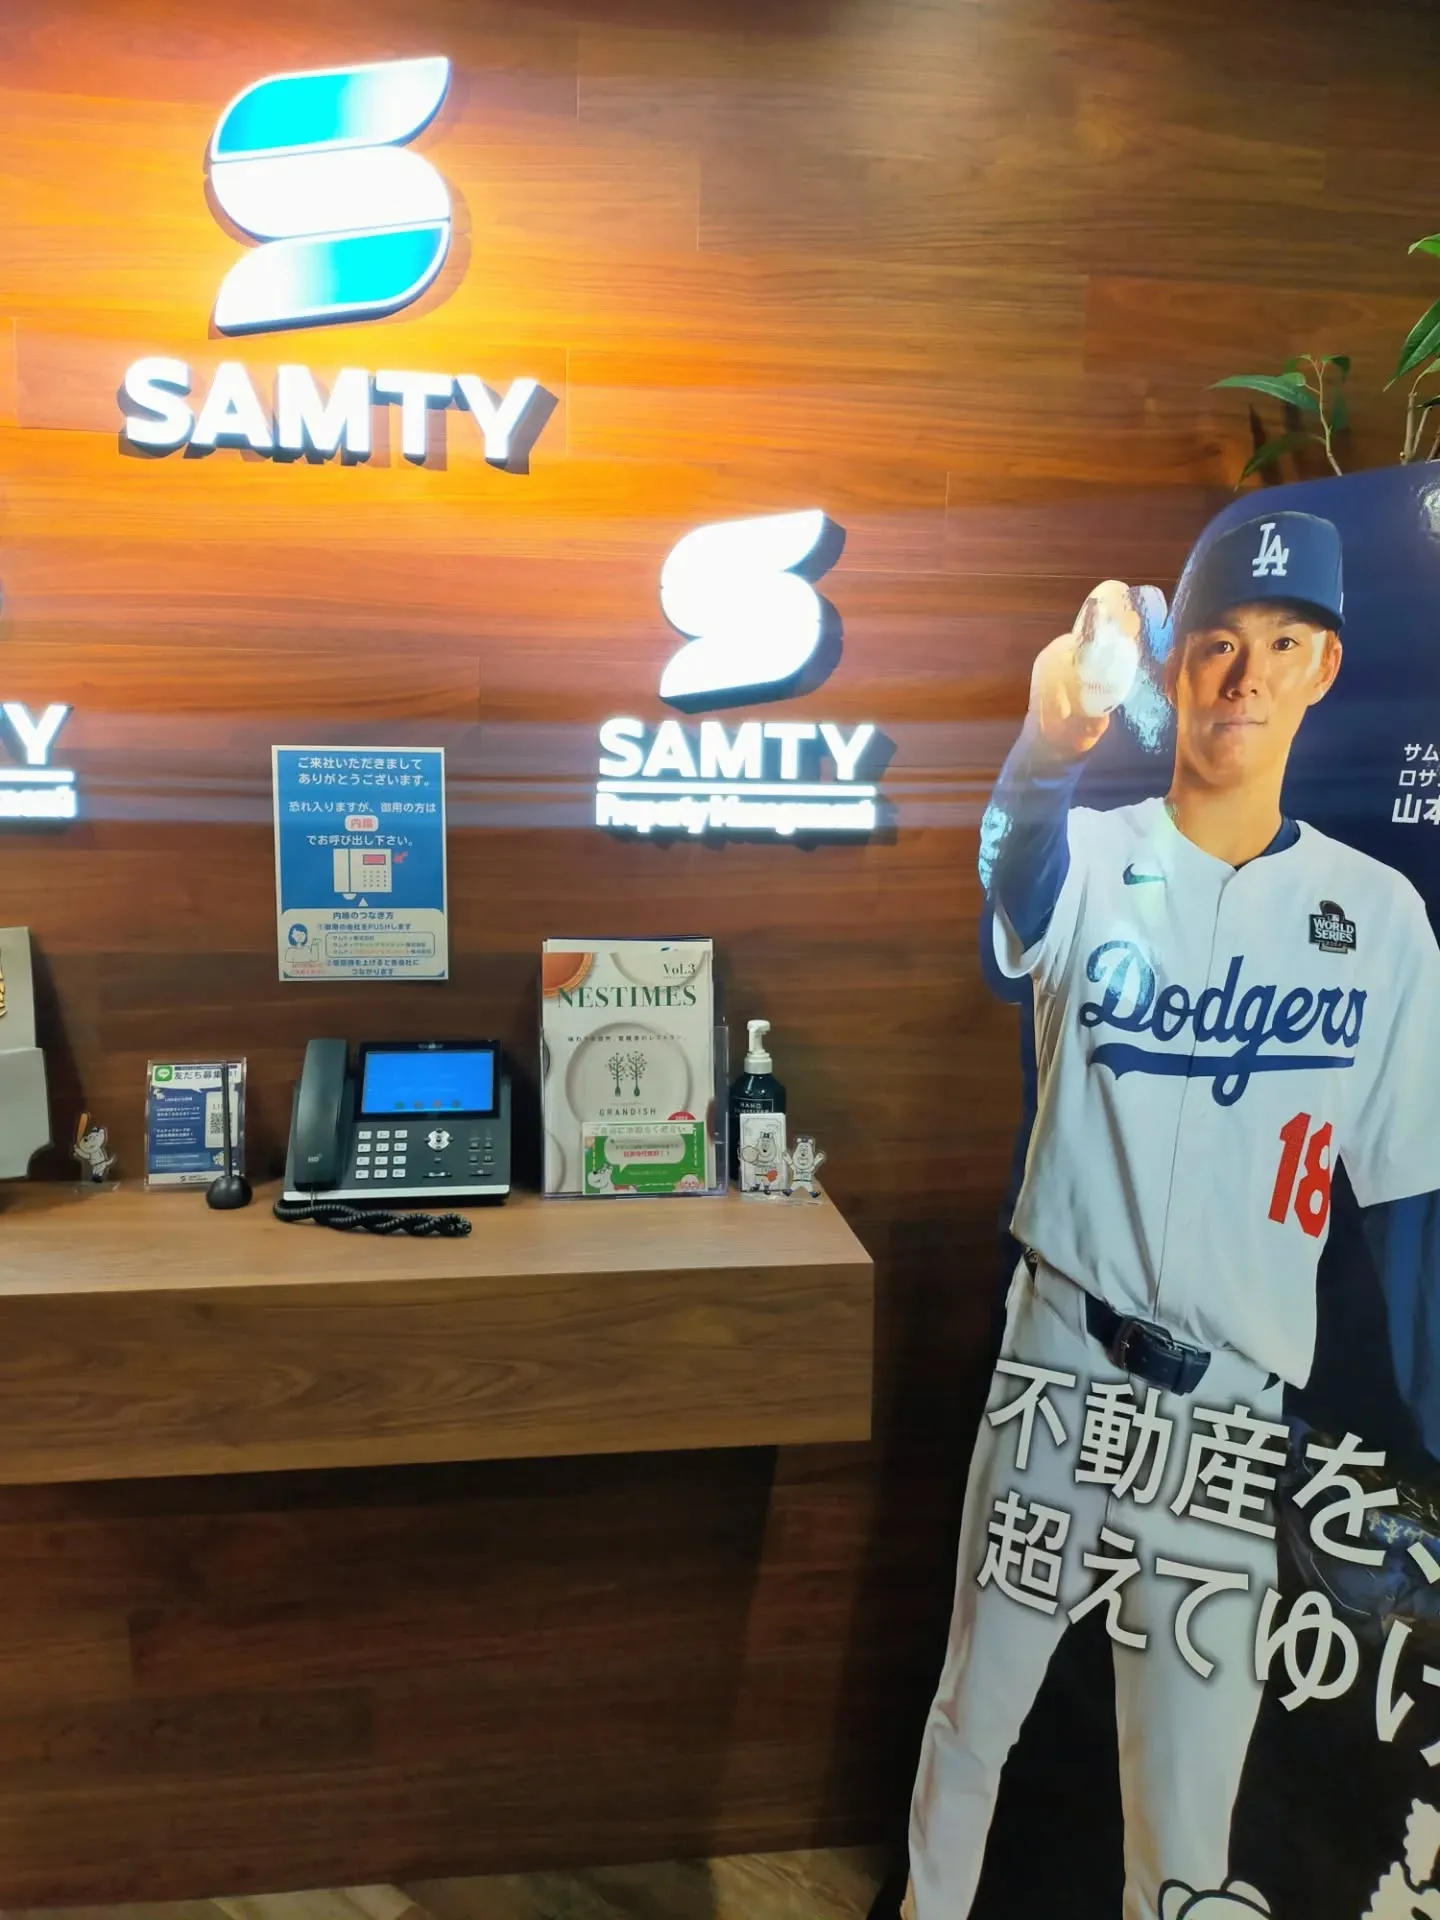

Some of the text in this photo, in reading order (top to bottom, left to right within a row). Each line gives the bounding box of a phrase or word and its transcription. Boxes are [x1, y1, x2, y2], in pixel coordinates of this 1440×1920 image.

[122, 356, 540, 463] SAMTY
[1252, 522, 1289, 577] LA
[598, 717, 876, 781] SAMTY
[297, 757, 423, 770] ご来社いただきまして
[298, 773, 430, 786] ありがとうございます。
[1398, 769, 1440, 787] ロサ
[288, 801, 437, 814] 恐れ入りますが、御用の方は
[306, 835, 413, 847] でお呼び出し下さい。
[1313, 918, 1355, 934] WORLD
[1314, 928, 1354, 943] SERIES
[662, 963, 696, 974] Vol.3
[557, 985, 697, 1008] NESTIMES
[1079, 939, 1368, 1107] Dodgers
[598, 1108, 657, 1117] GRANDISH
[1267, 1112, 1333, 1239] 18
